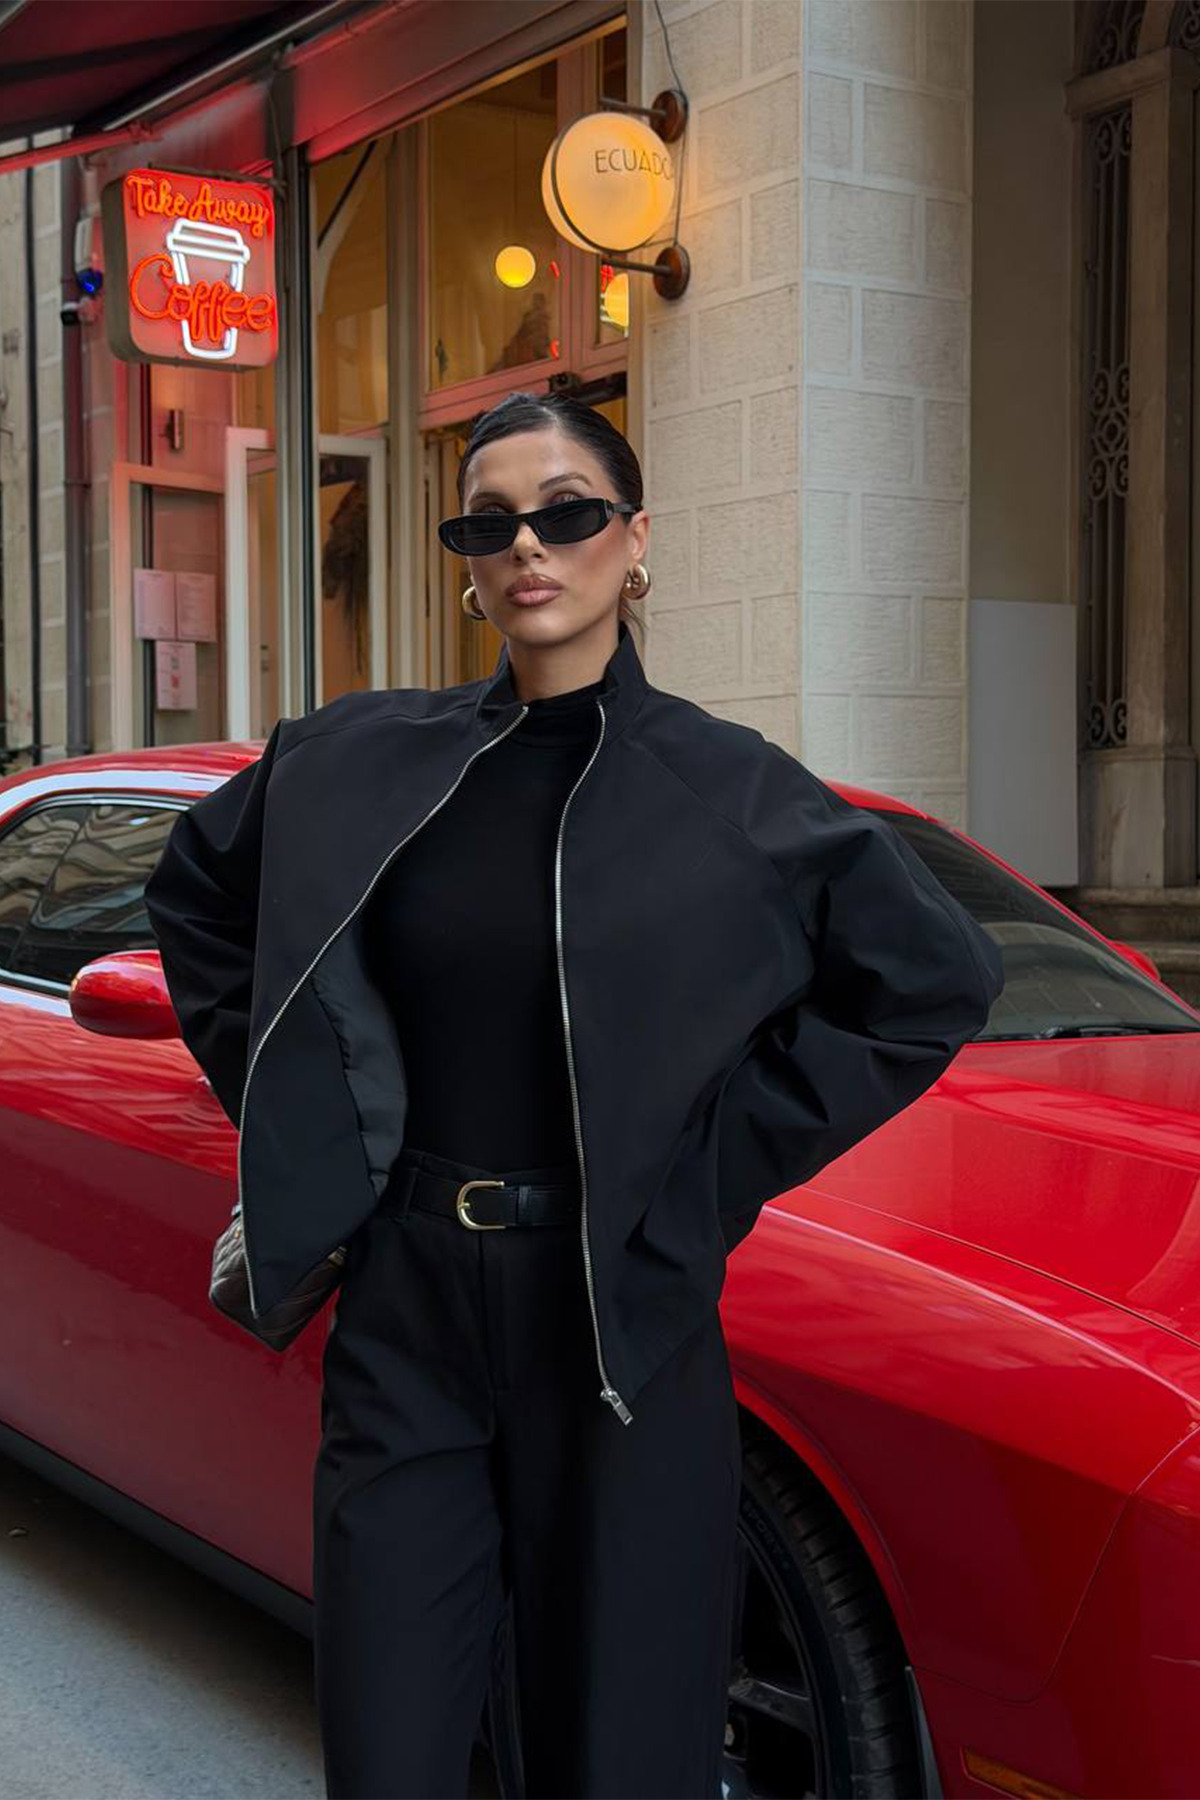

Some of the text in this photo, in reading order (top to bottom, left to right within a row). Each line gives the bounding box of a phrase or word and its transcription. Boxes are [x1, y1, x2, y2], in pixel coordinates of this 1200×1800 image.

[126, 176, 268, 237] Take Away
[130, 252, 272, 342] Coffee
